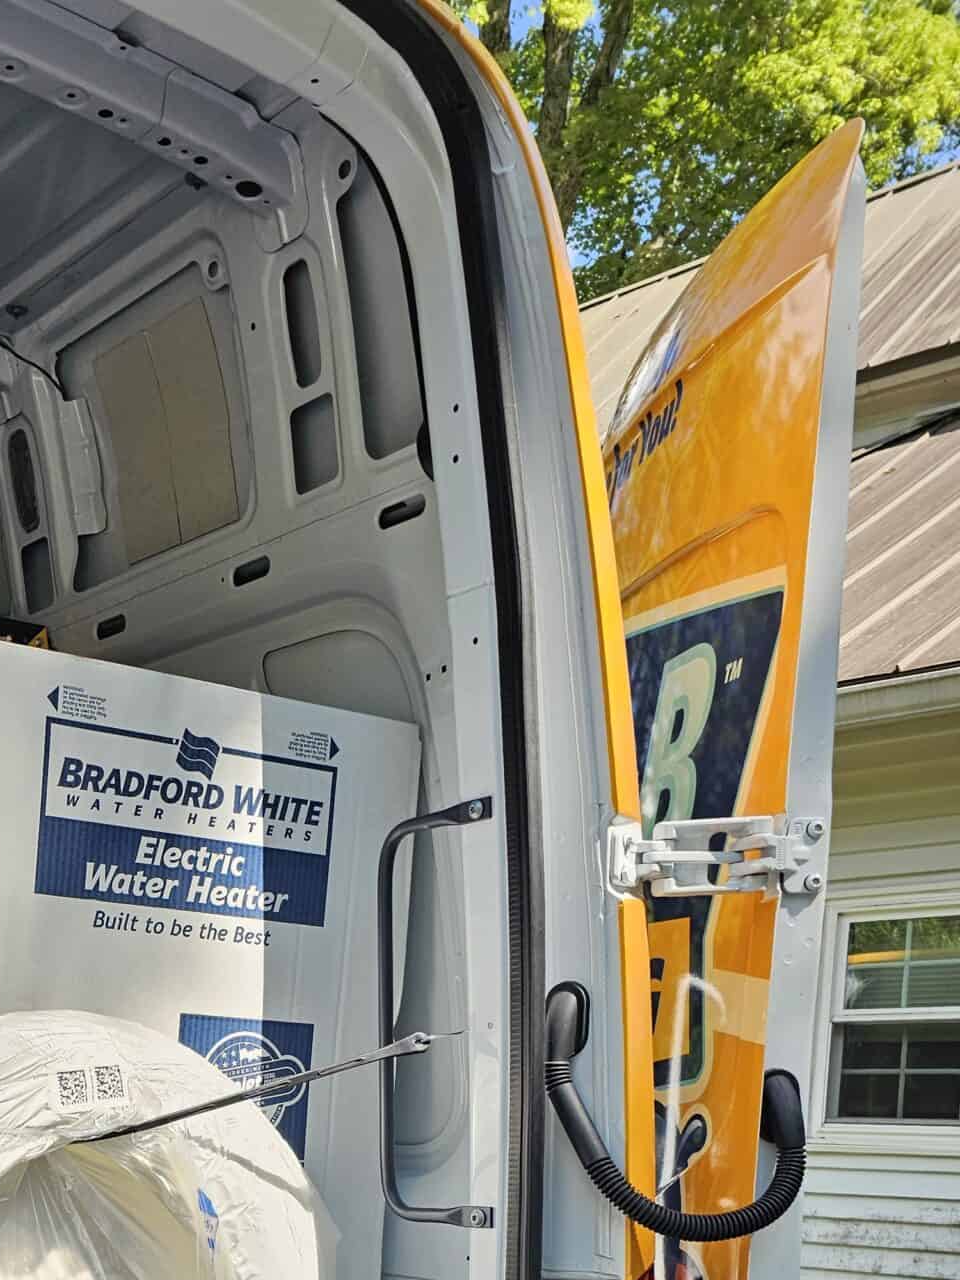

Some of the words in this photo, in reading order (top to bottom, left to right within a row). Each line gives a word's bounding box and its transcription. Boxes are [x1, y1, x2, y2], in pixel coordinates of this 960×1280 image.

[57, 757, 224, 811] BRADFORD
[232, 784, 324, 826] WHITE
[66, 794, 165, 821] WATER
[187, 812, 313, 842] HEATERS
[135, 835, 246, 876] Electric
[84, 861, 179, 900] Water
[187, 876, 289, 913] Heater
[93, 910, 139, 932] Built
[144, 917, 165, 934] to
[170, 918, 194, 938] be
[199, 922, 228, 942] the
[233, 926, 272, 947] Best
